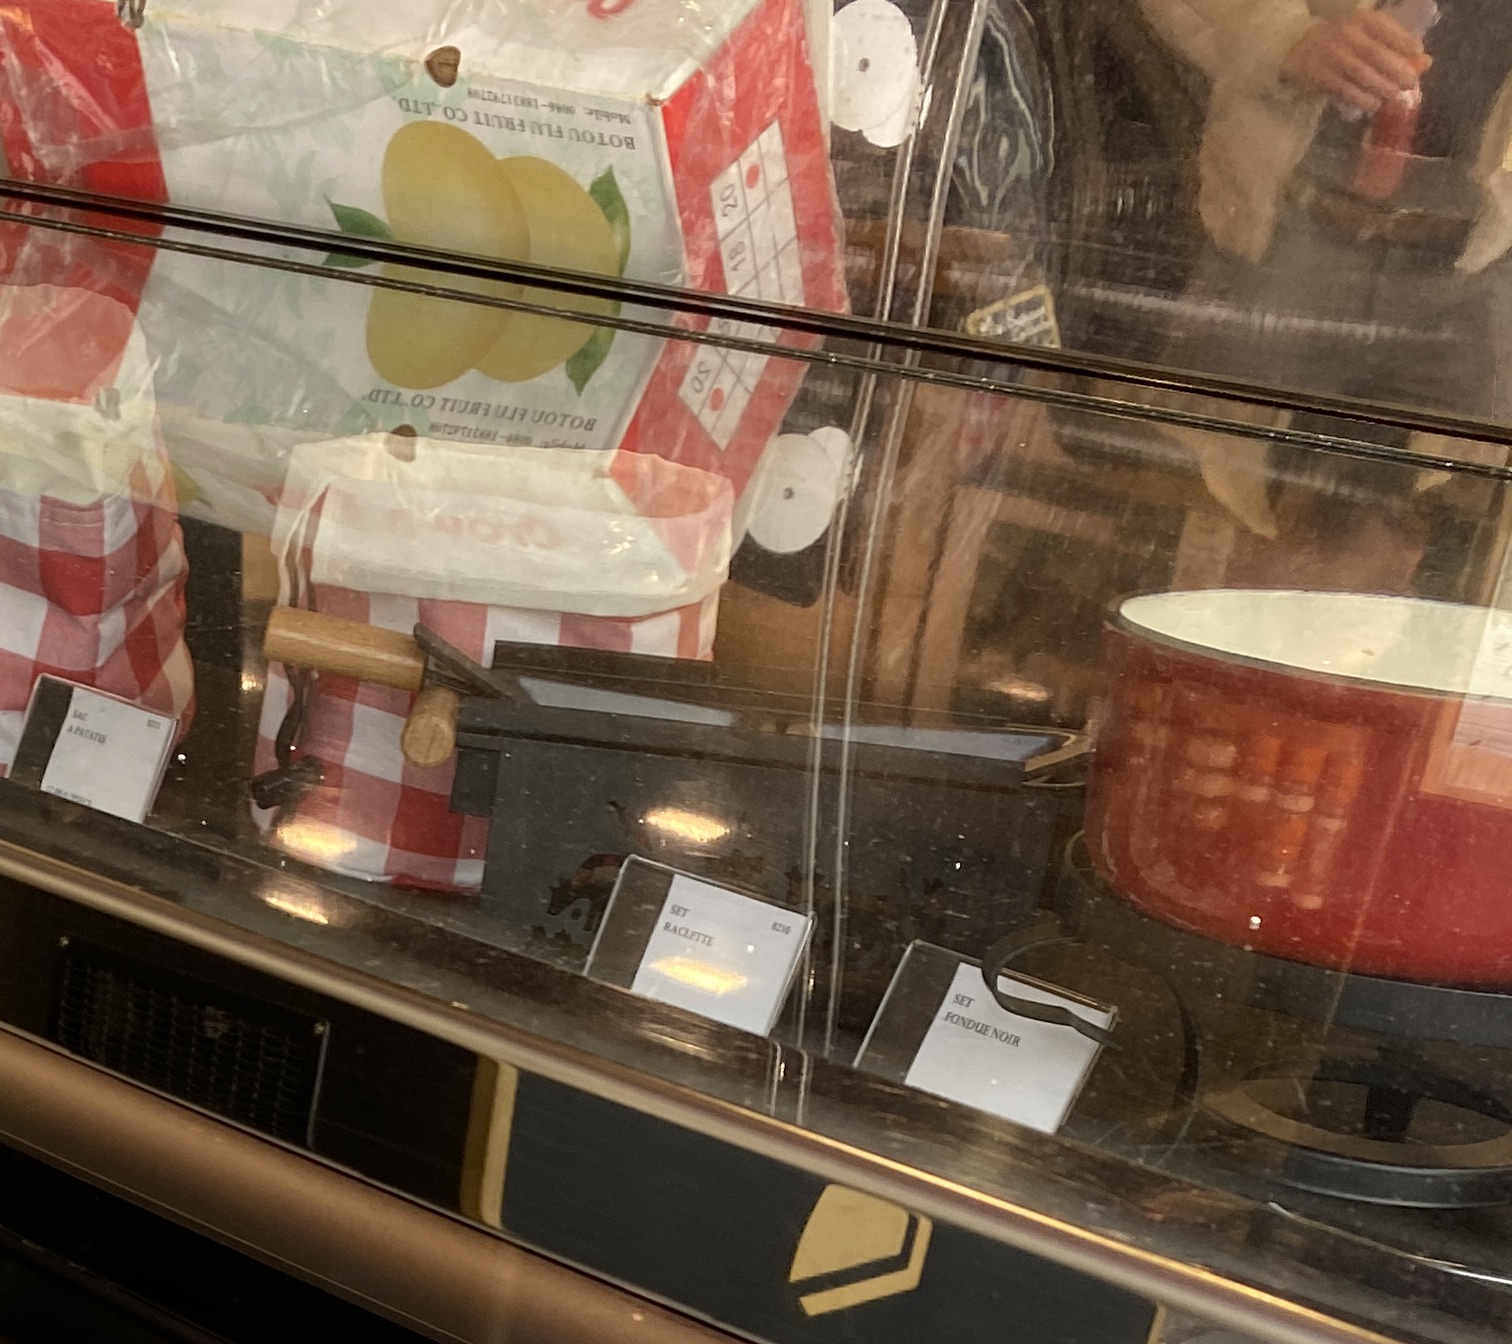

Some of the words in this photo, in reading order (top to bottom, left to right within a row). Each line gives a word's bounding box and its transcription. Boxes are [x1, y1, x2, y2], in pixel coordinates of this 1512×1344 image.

[474, 111, 526, 132] FRUIT
[570, 128, 636, 150] BOTOU
[670, 904, 690, 918] SET
[664, 921, 714, 947] RACLETTE
[953, 994, 974, 1008] SET
[944, 1011, 990, 1036] FONDUE
[990, 1028, 1021, 1047] NOIR
